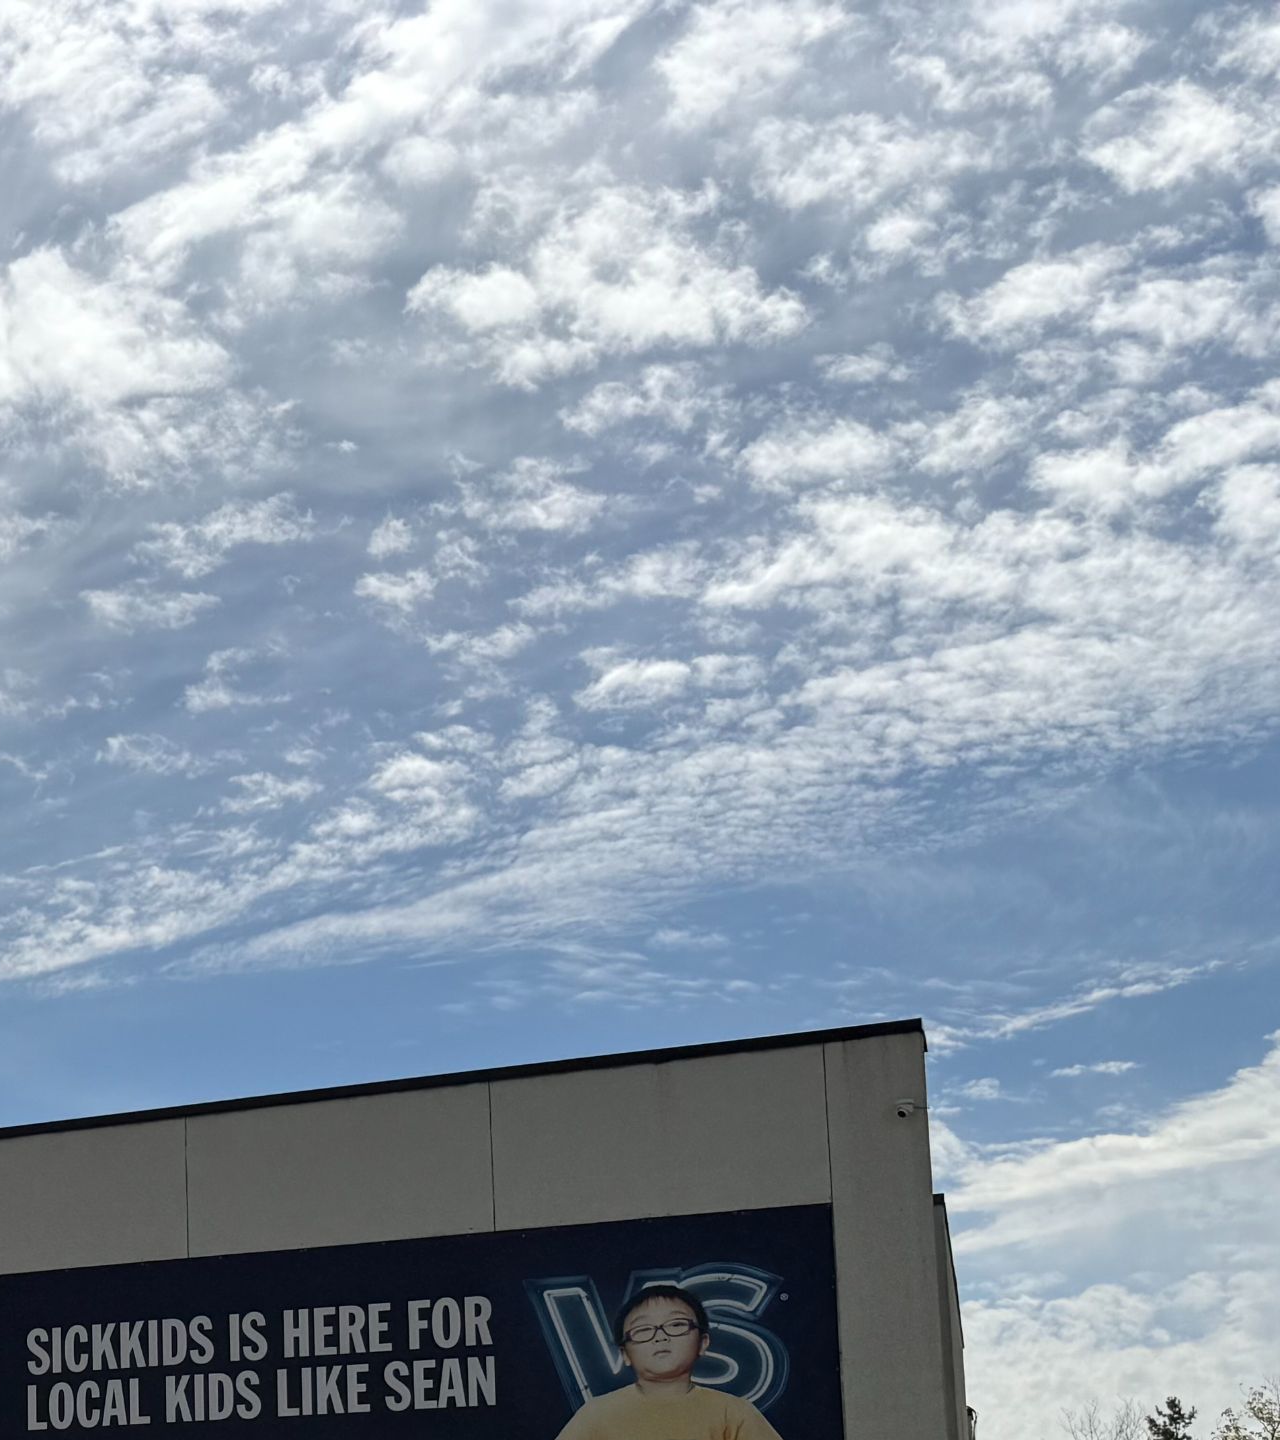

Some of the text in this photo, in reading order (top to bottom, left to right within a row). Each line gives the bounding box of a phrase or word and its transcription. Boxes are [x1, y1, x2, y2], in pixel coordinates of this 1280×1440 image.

[26, 1295, 493, 1376] SICKKIDS IS HERE FOR
[26, 1355, 497, 1431] LOCAL KIDS LIKE SEAN
